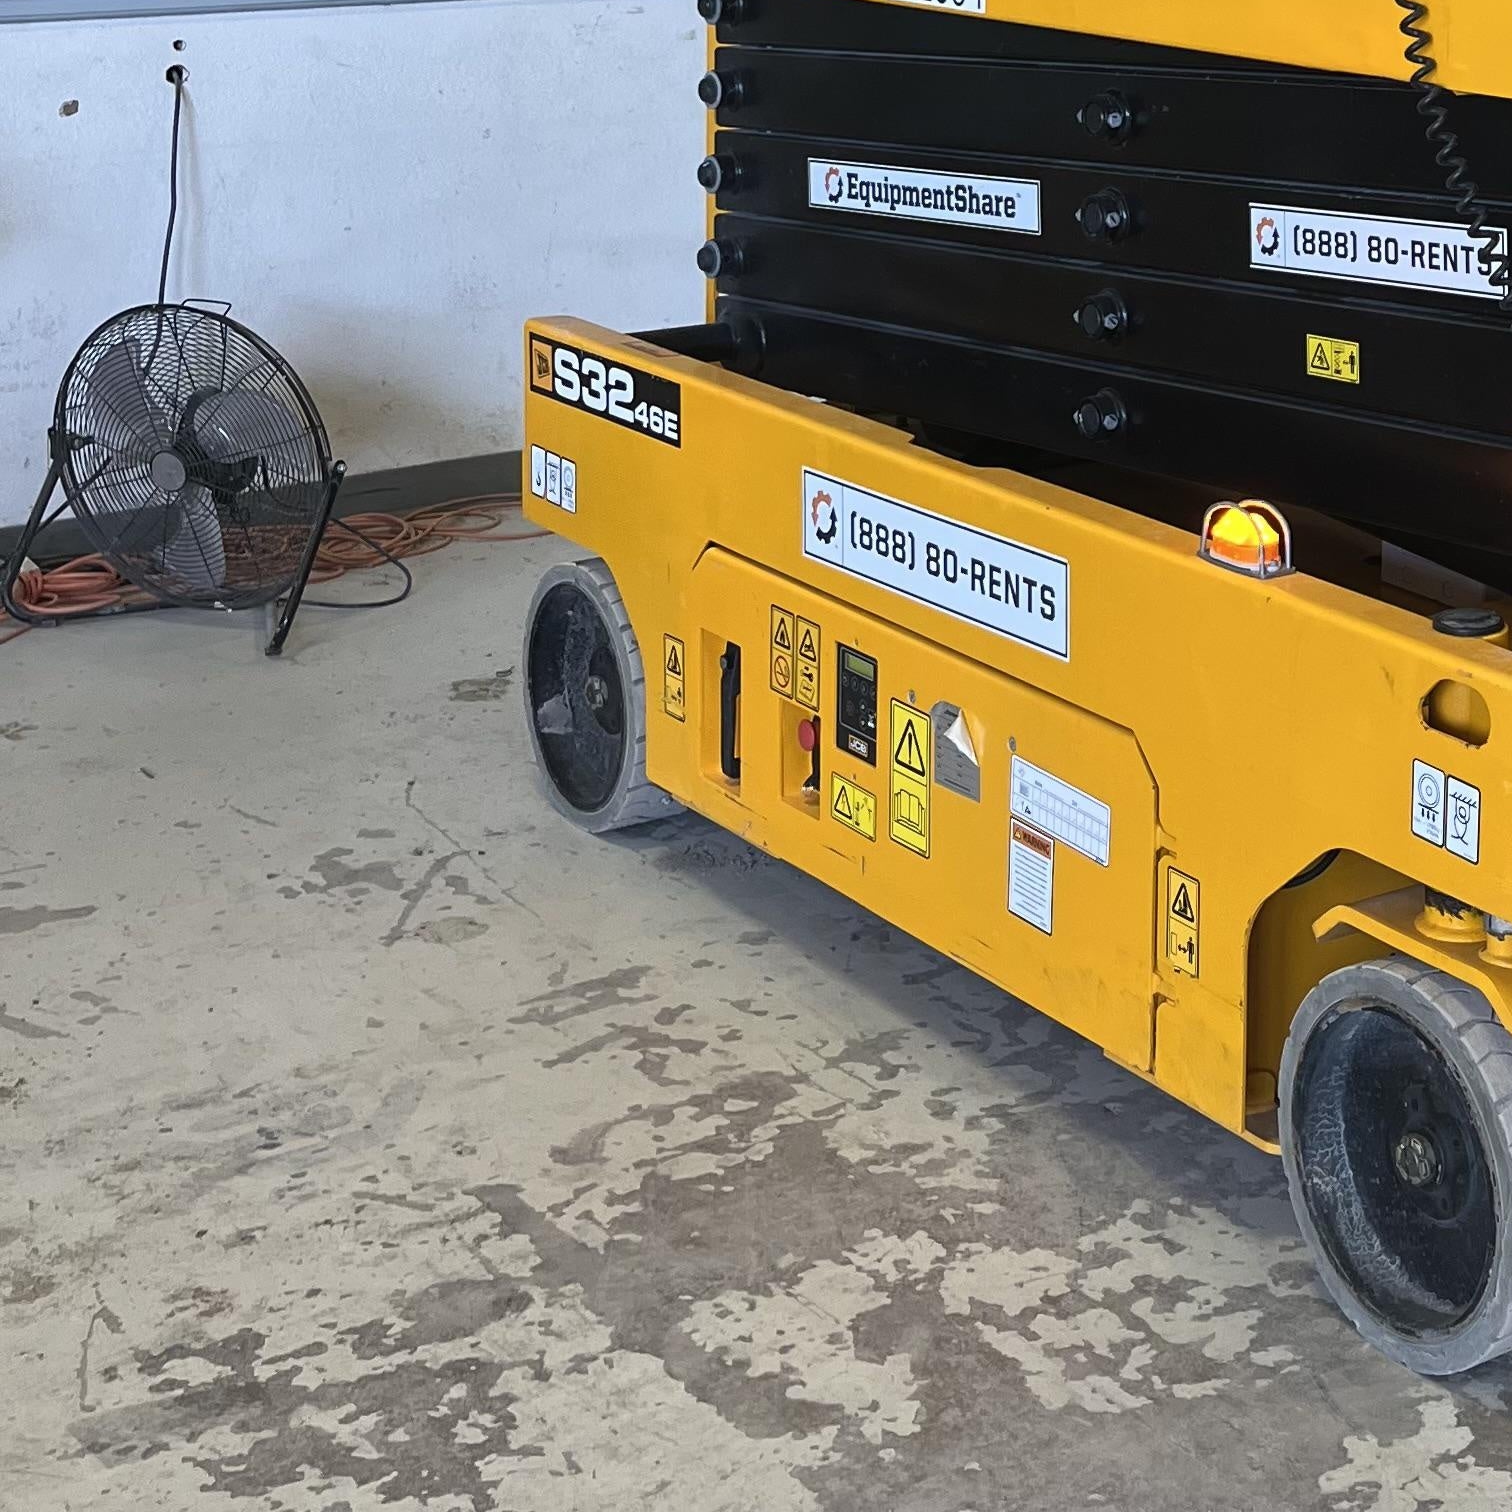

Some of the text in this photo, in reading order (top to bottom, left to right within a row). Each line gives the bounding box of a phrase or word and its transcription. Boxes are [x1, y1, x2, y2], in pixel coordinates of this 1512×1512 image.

[846, 172, 1016, 218] EquipmentShare
[1293, 224, 1357, 263] (888)
[850, 510, 1056, 622] (888) 80-RENTS
[850, 738, 867, 754] JCB
[1022, 828, 1050, 856] WARNING
